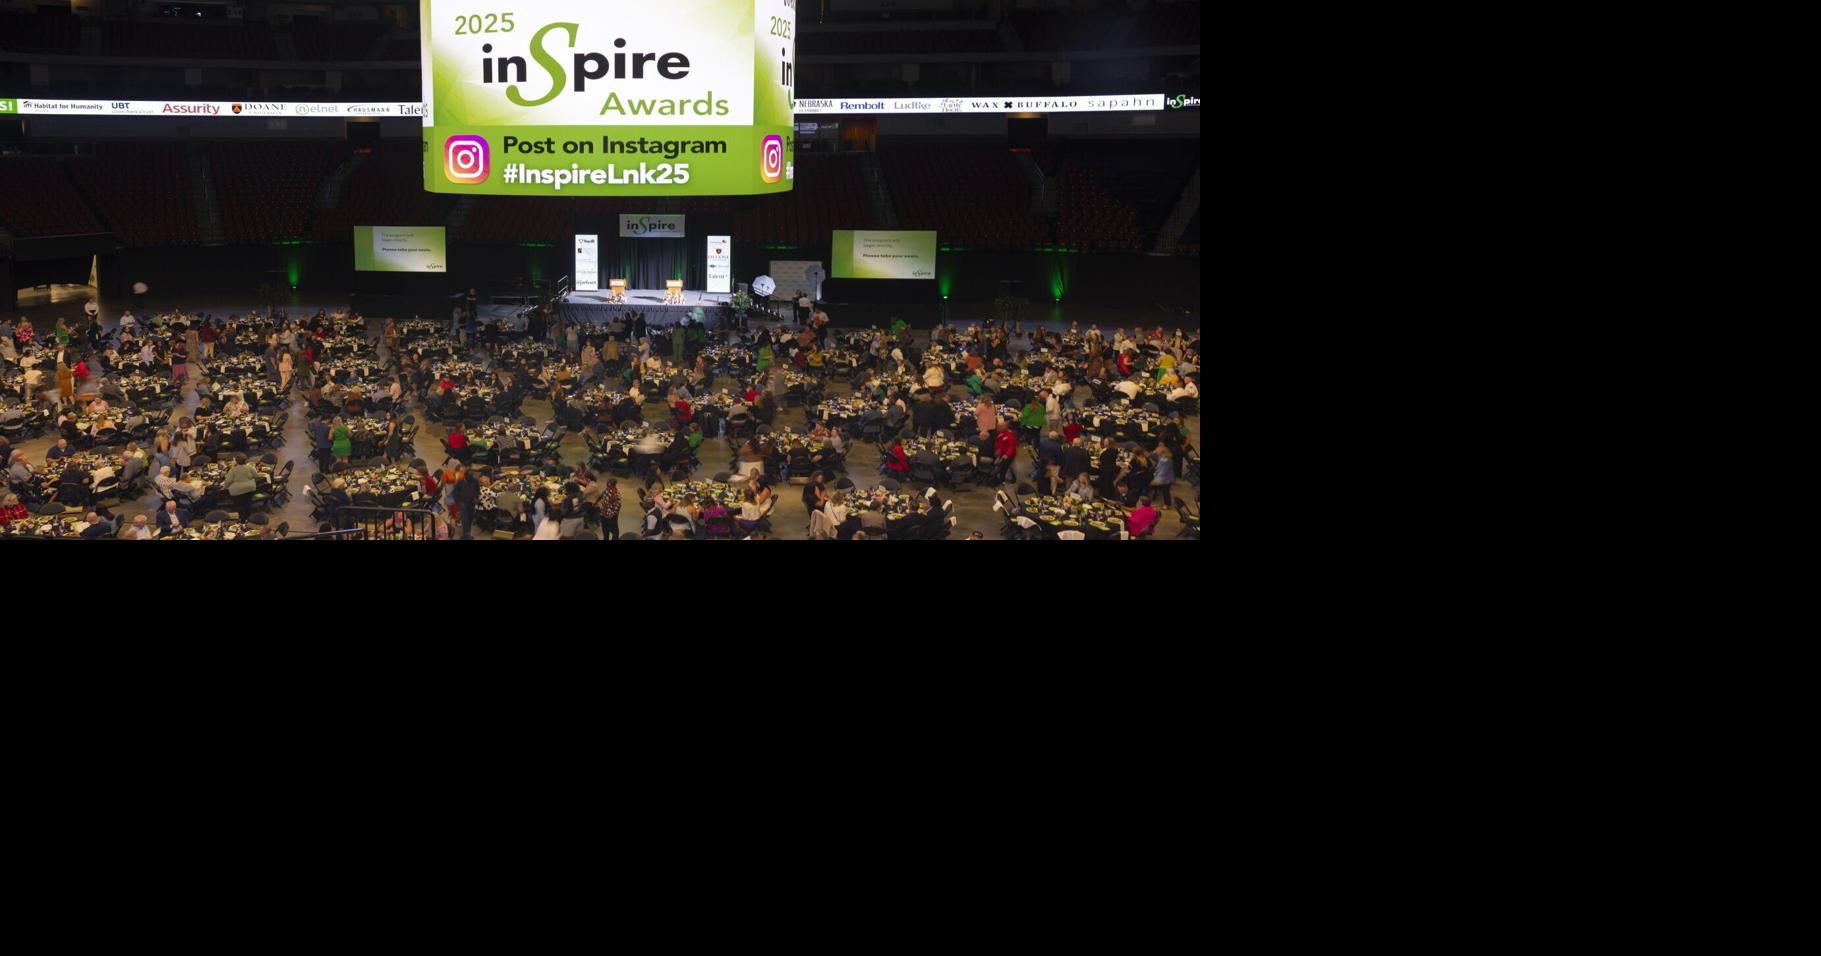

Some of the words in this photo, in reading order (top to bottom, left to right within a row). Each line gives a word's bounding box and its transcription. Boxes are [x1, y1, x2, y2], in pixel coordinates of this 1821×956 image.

[454, 12, 515, 36] 2025
[481, 21, 691, 108] inSpire
[70, 103, 103, 111] Humanity
[244, 103, 287, 111] DOANE
[599, 90, 730, 117] Awards
[799, 100, 833, 108] NEBRASKA
[840, 101, 884, 110] Rembolt
[1017, 101, 1078, 109] BUFFALO
[1087, 97, 1156, 109] sapahn
[1166, 94, 1200, 109] inSpir
[162, 103, 220, 115] Assurity
[503, 136, 555, 155] Post
[562, 141, 594, 155] on
[603, 136, 727, 159] Instagram
[503, 162, 690, 190] #InspireLnk25
[626, 217, 676, 235] inSpire
